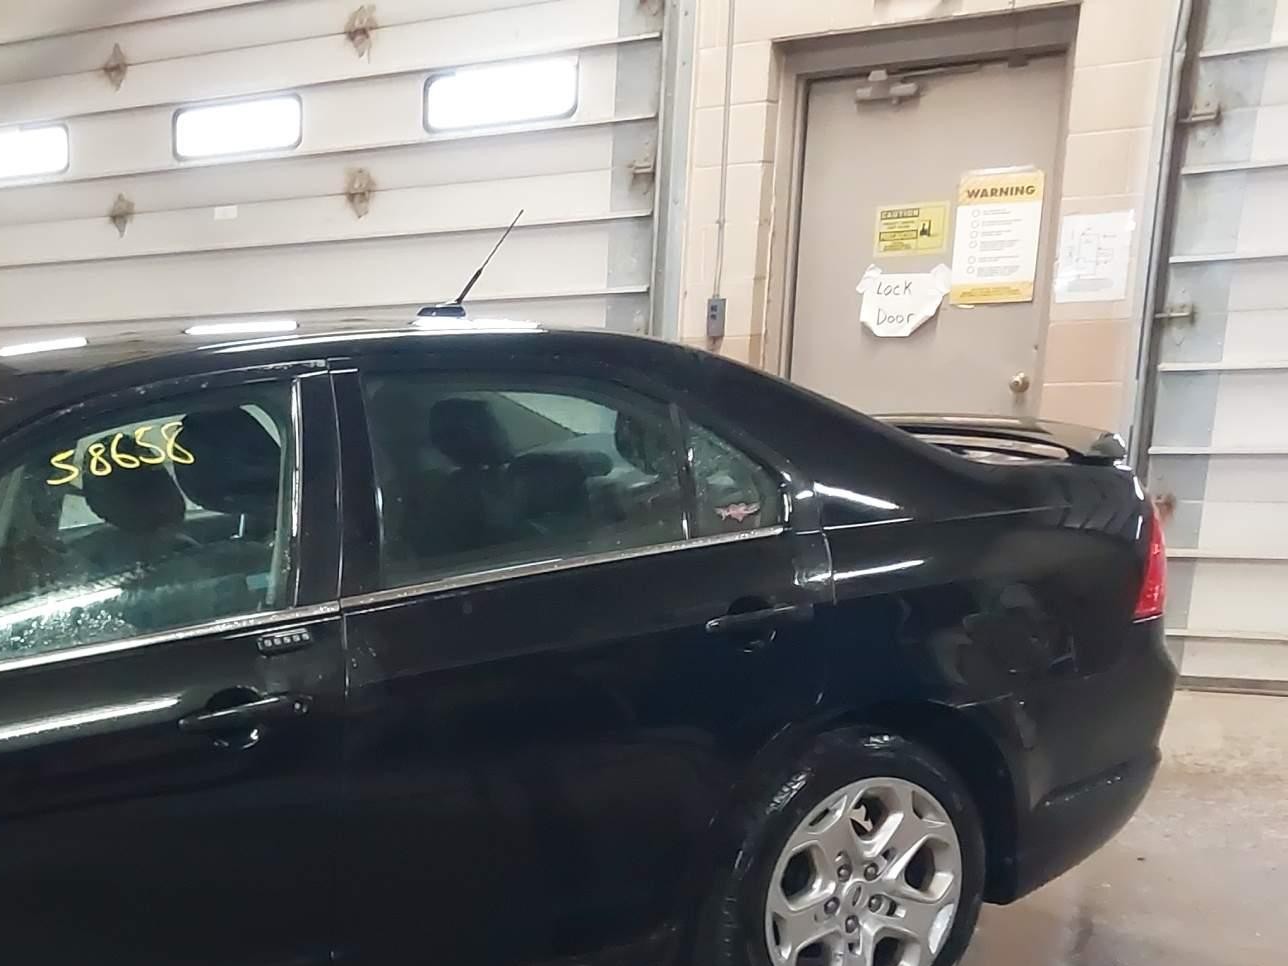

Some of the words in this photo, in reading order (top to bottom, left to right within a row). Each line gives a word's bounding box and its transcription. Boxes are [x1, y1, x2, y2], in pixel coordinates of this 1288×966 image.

[965, 185, 1036, 199] WARNING
[876, 308, 915, 326] Door
[46, 422, 195, 486] 58658
